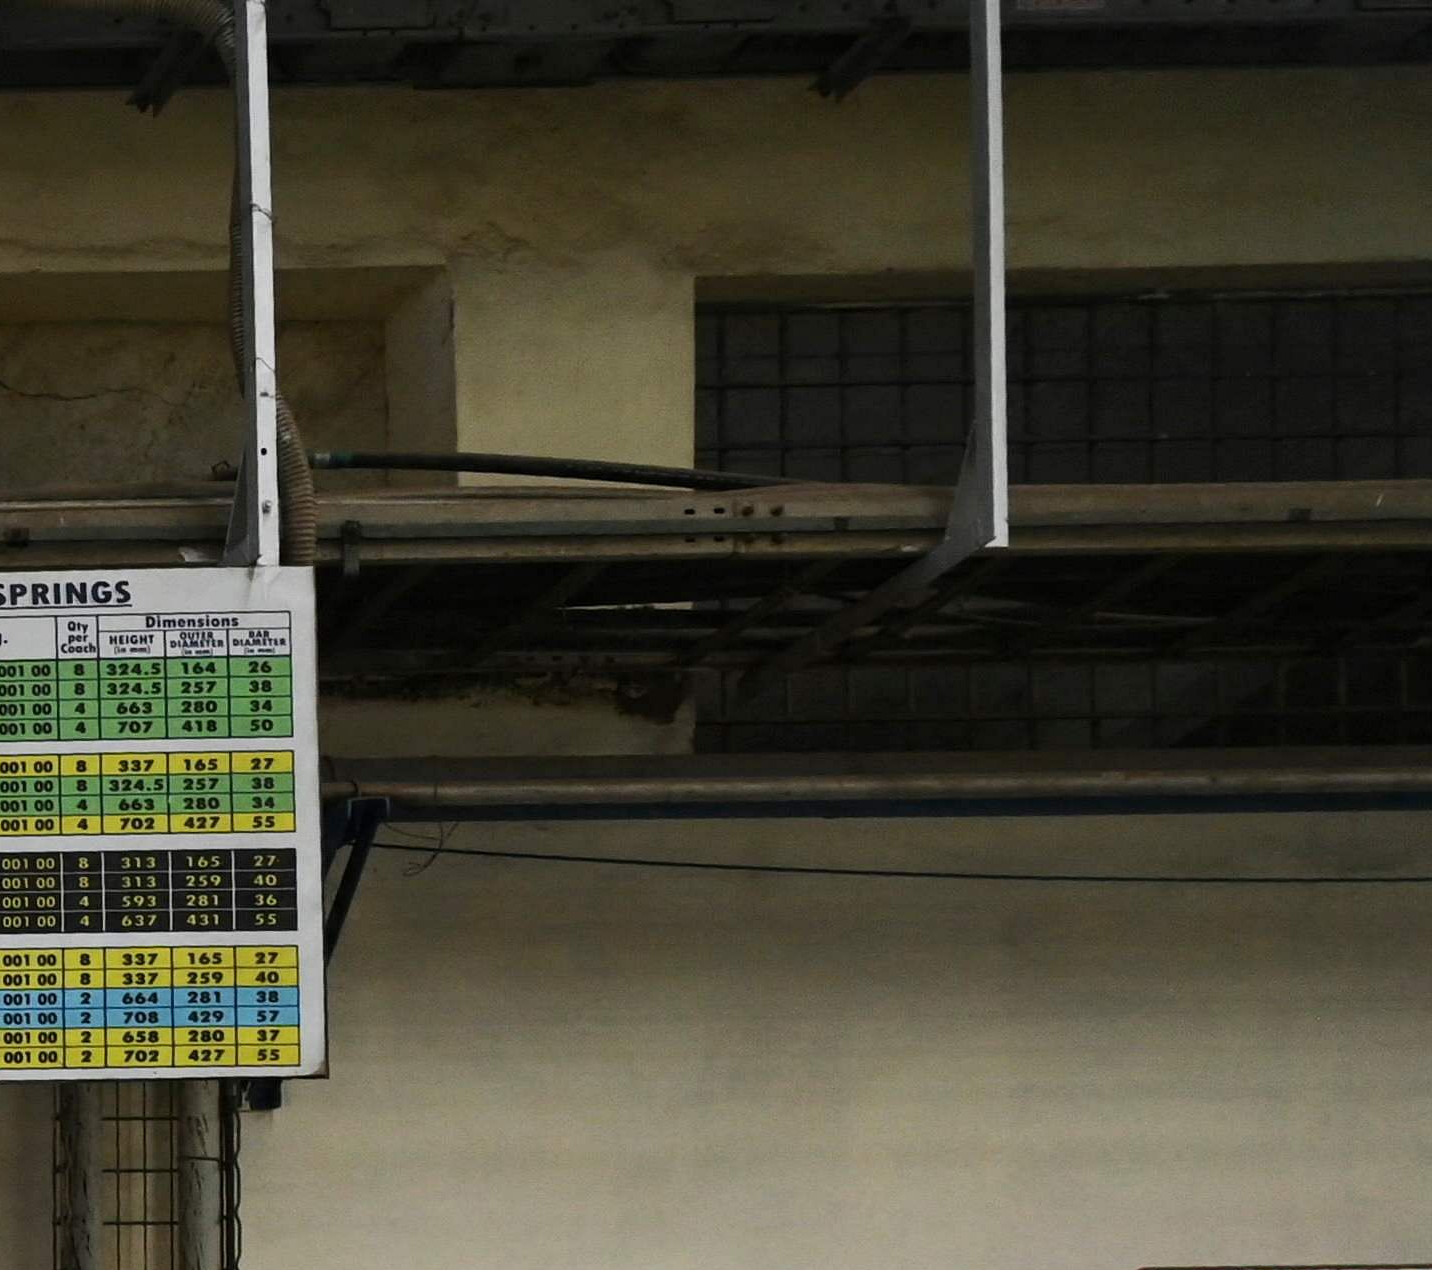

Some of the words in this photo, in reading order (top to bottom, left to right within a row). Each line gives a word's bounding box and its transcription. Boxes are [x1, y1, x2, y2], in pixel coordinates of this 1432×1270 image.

[67, 621, 88, 633] Qty
[145, 616, 239, 628] Dimensions
[68, 635, 88, 643] per
[109, 635, 154, 645] HEIGHT
[61, 644, 96, 654] Coach
[0, 664, 28, 678] 001
[32, 663, 51, 677] 00
[74, 665, 85, 675] 8
[106, 663, 161, 675] 324.5
[181, 663, 216, 674] 164
[248, 662, 272, 673] 26
